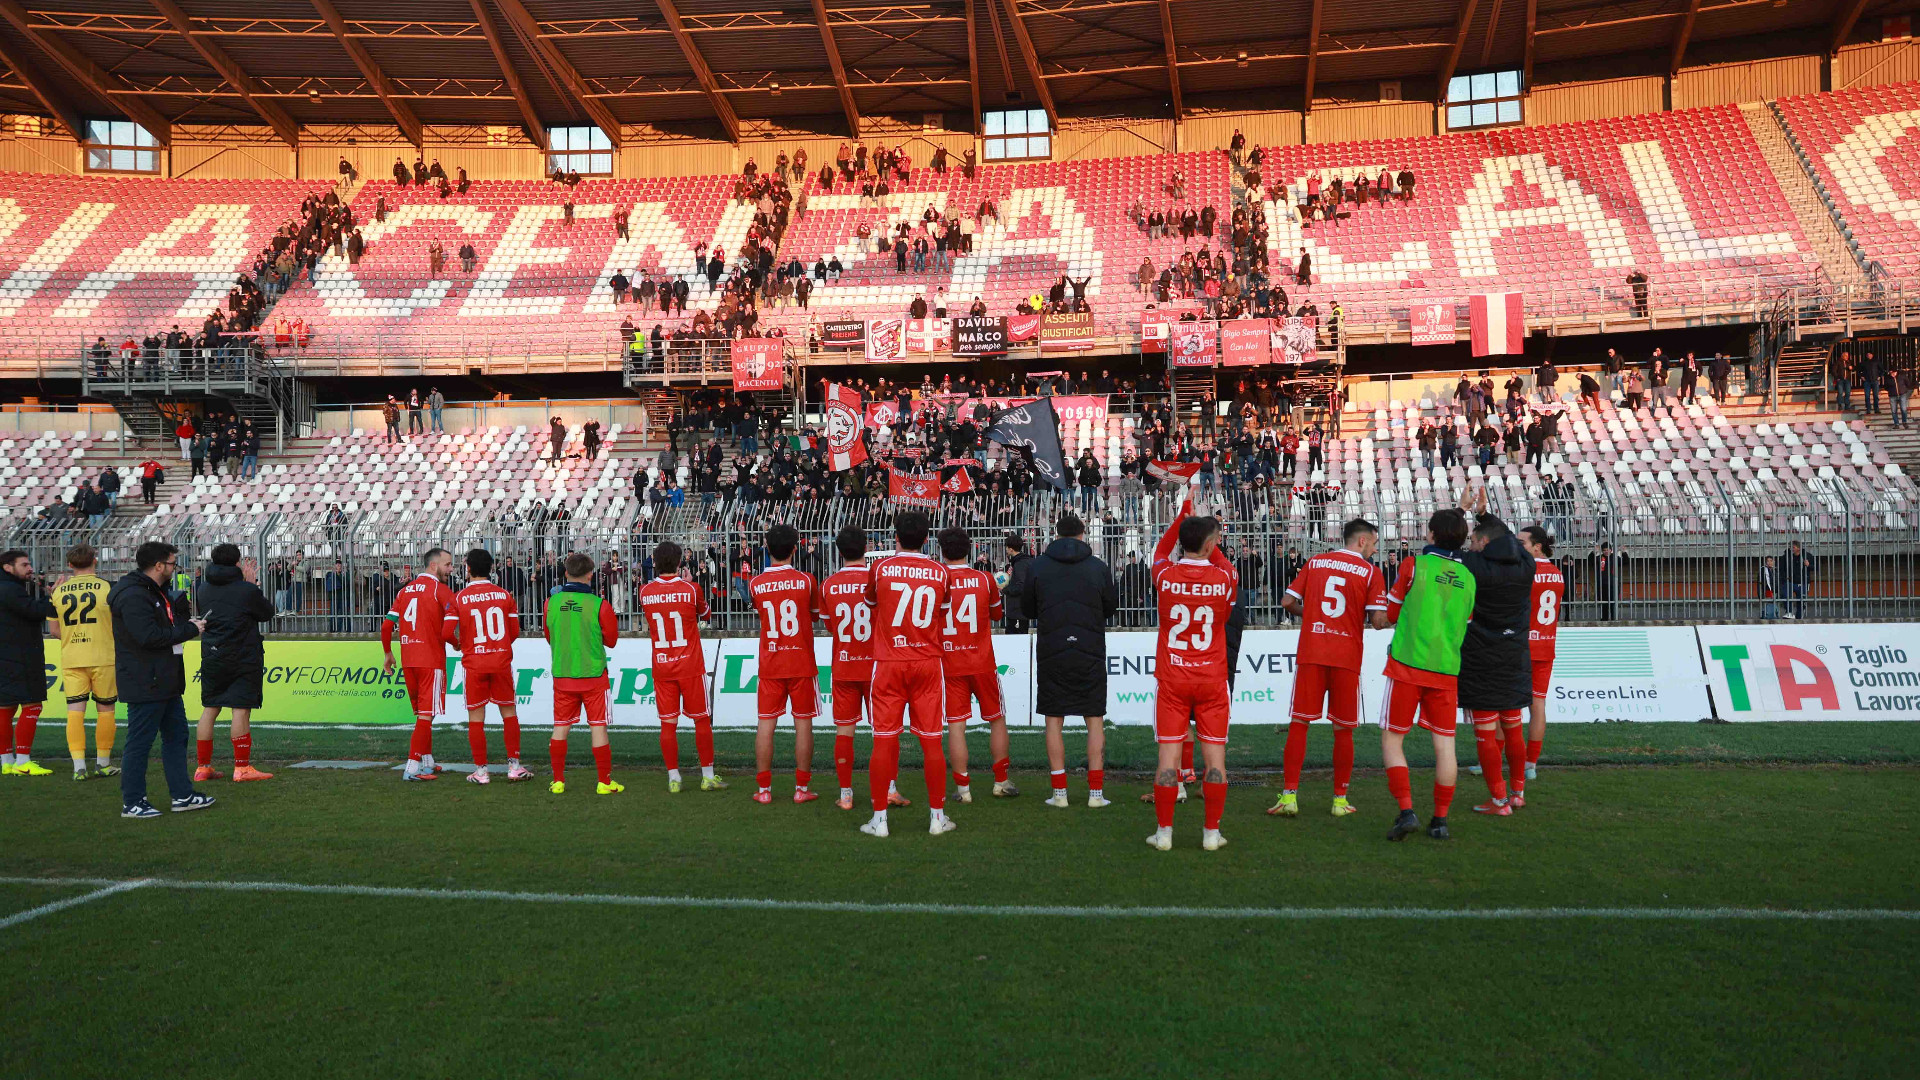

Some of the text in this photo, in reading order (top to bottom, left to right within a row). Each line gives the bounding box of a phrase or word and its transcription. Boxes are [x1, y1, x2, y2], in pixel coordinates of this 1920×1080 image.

[958, 317, 1000, 328] DAVIDE
[1044, 313, 1090, 323] ASSENTI
[826, 324, 862, 332] CASTELVETRO
[1042, 327, 1093, 338] GIUSTIFICATI
[1242, 328, 1268, 338] Sempre
[958, 332, 1002, 342] MARCO
[1204, 339, 1214, 347] 92
[736, 344, 778, 353] GRUPPO
[974, 343, 1002, 351] sempre
[736, 360, 780, 372] 19 92
[1176, 355, 1213, 364] BRIGADE
[881, 566, 943, 582] SARTORELLI
[1312, 559, 1369, 578] TAUGOURDEAU
[60, 582, 101, 593] RIBERO
[405, 584, 426, 593] SILVA
[754, 580, 805, 595] MAZZAGLIA
[1162, 580, 1226, 596] POLEDRI
[462, 592, 507, 605] D'AGOSTINO
[643, 593, 691, 605] BIANCHETTI
[1321, 576, 1346, 618] 5
[62, 592, 97, 626] 22
[890, 582, 936, 628] 70
[1537, 590, 1556, 625] 8
[403, 597, 418, 631] 4
[763, 599, 799, 639] 18
[943, 594, 977, 635] 14
[471, 606, 506, 644] 10
[835, 602, 871, 642] 28
[1168, 604, 1214, 650] 23
[652, 611, 688, 649] 11
[1840, 645, 1908, 667] Taglio
[292, 688, 377, 697] www.getec-italia.com
[1555, 686, 1658, 700] ScreenLine
[1558, 704, 1662, 715] by Pellini
